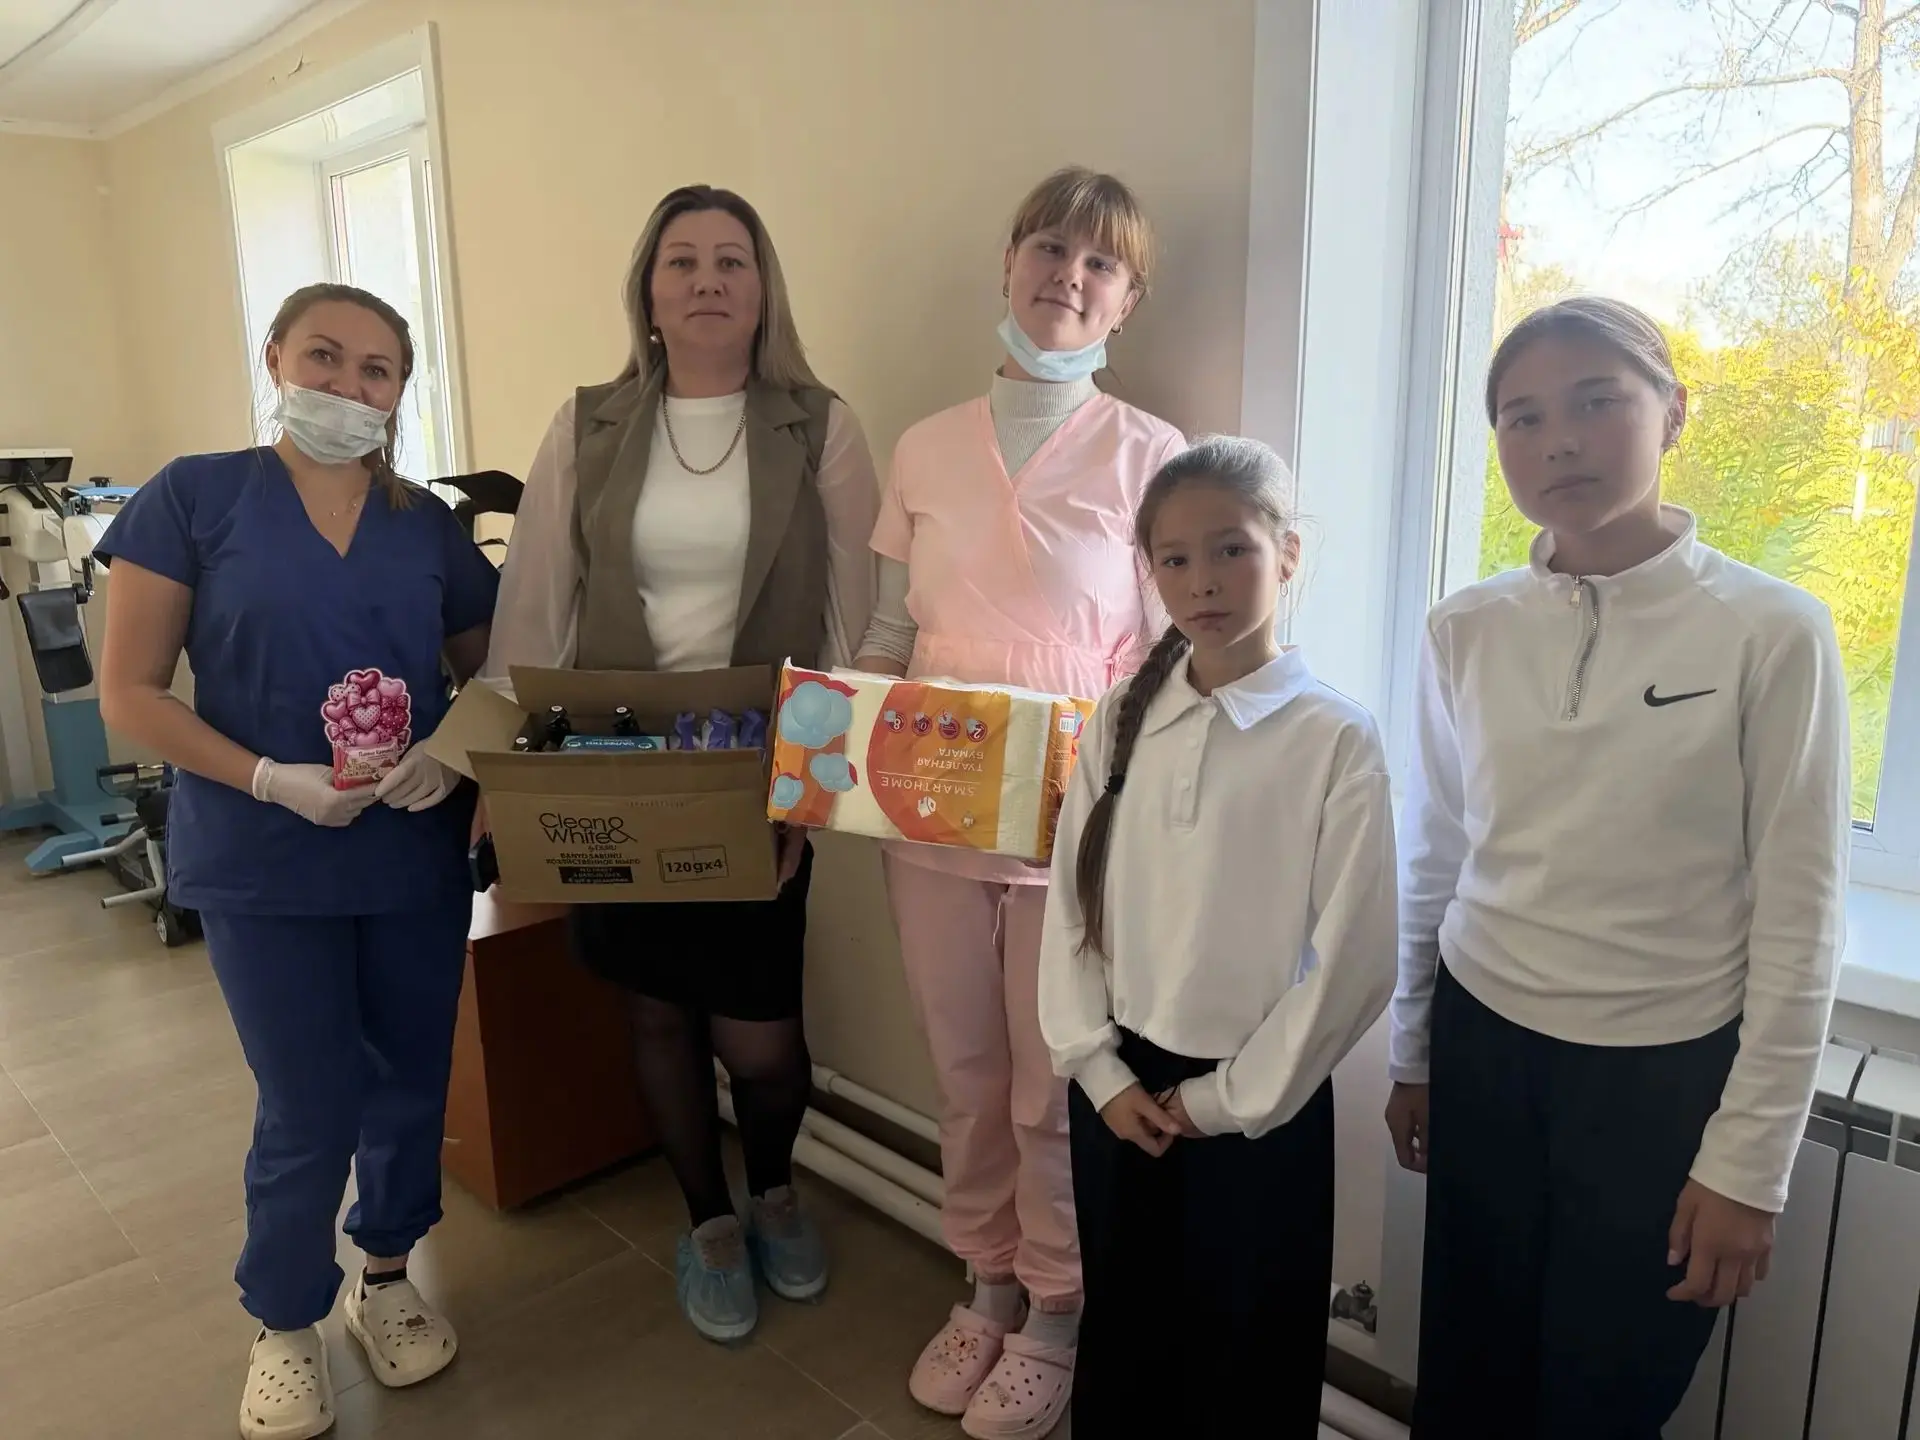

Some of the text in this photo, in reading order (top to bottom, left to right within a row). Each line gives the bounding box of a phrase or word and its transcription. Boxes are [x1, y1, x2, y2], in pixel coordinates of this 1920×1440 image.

[938, 747, 984, 760] БУМАГА
[916, 757, 984, 773] ТУАЛЕТНАЯ
[881, 776, 976, 797] SMARTHOME
[539, 813, 607, 832] Clean
[543, 828, 610, 844] White
